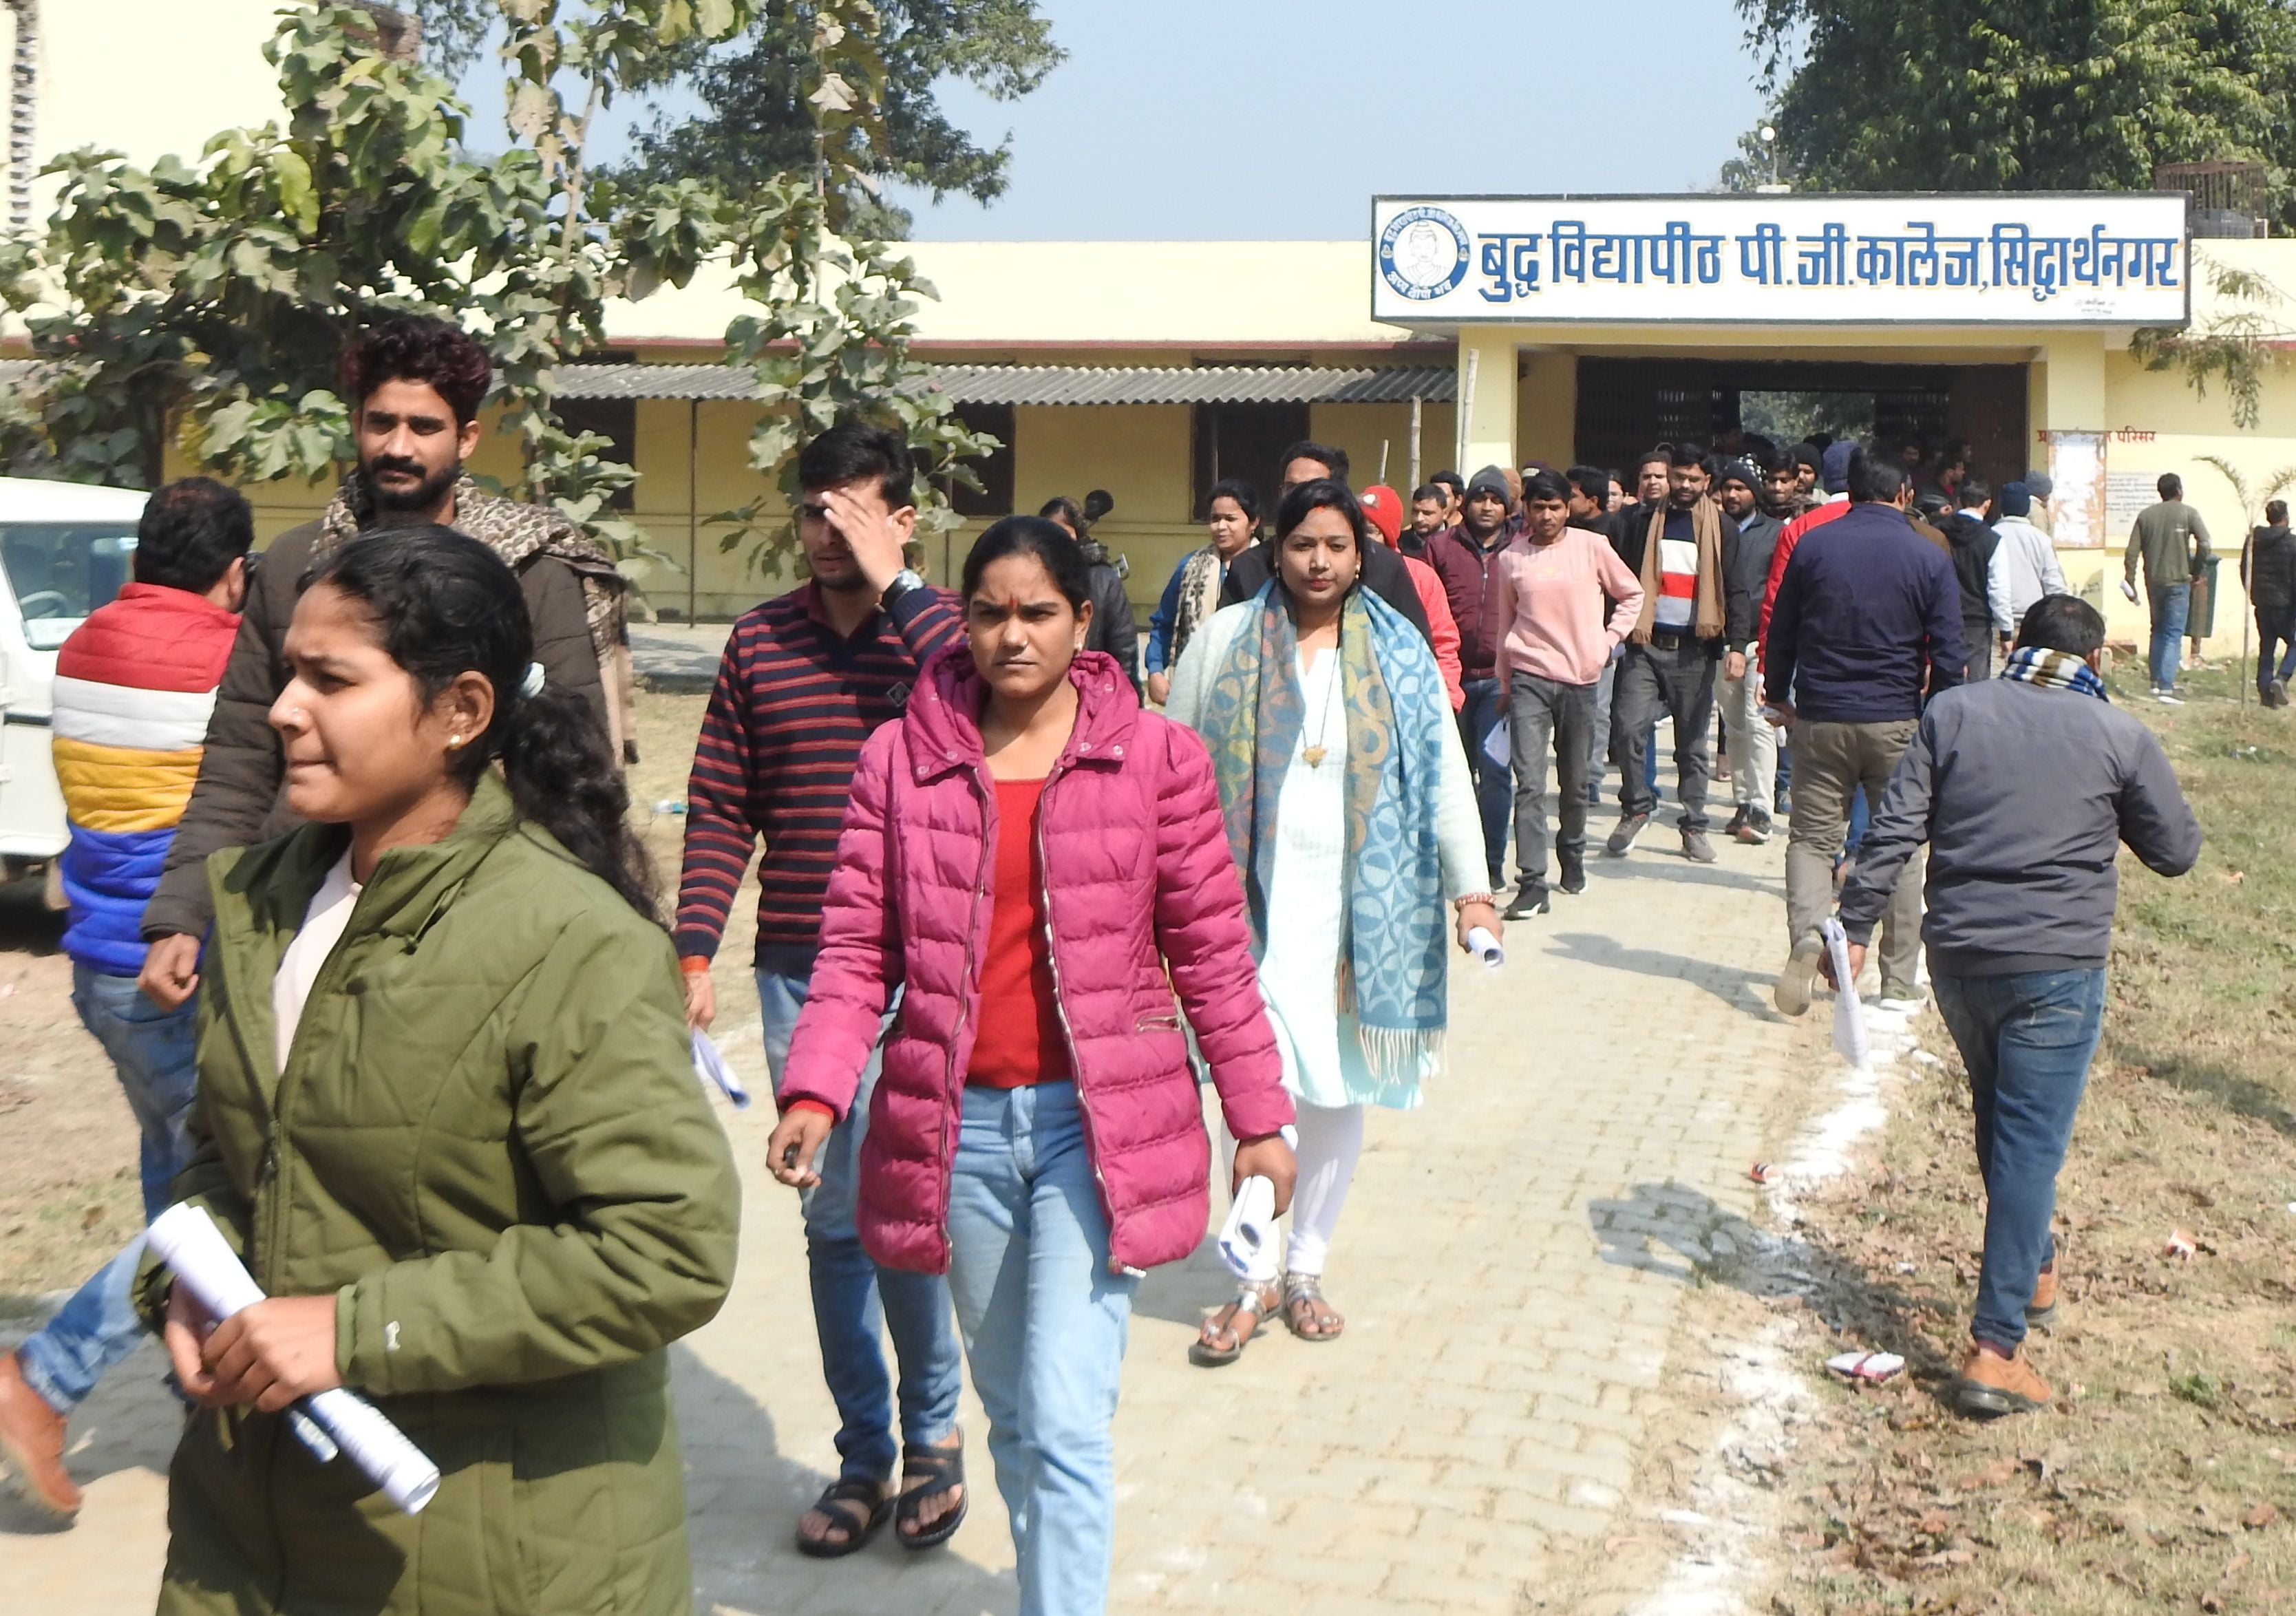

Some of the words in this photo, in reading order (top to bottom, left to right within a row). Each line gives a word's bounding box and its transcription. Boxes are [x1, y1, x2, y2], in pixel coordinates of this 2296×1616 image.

[1478, 233, 1542, 302] बुद्ध
[1546, 220, 1726, 284] विद्यापीठ
[2116, 425, 2157, 443] परिसर
